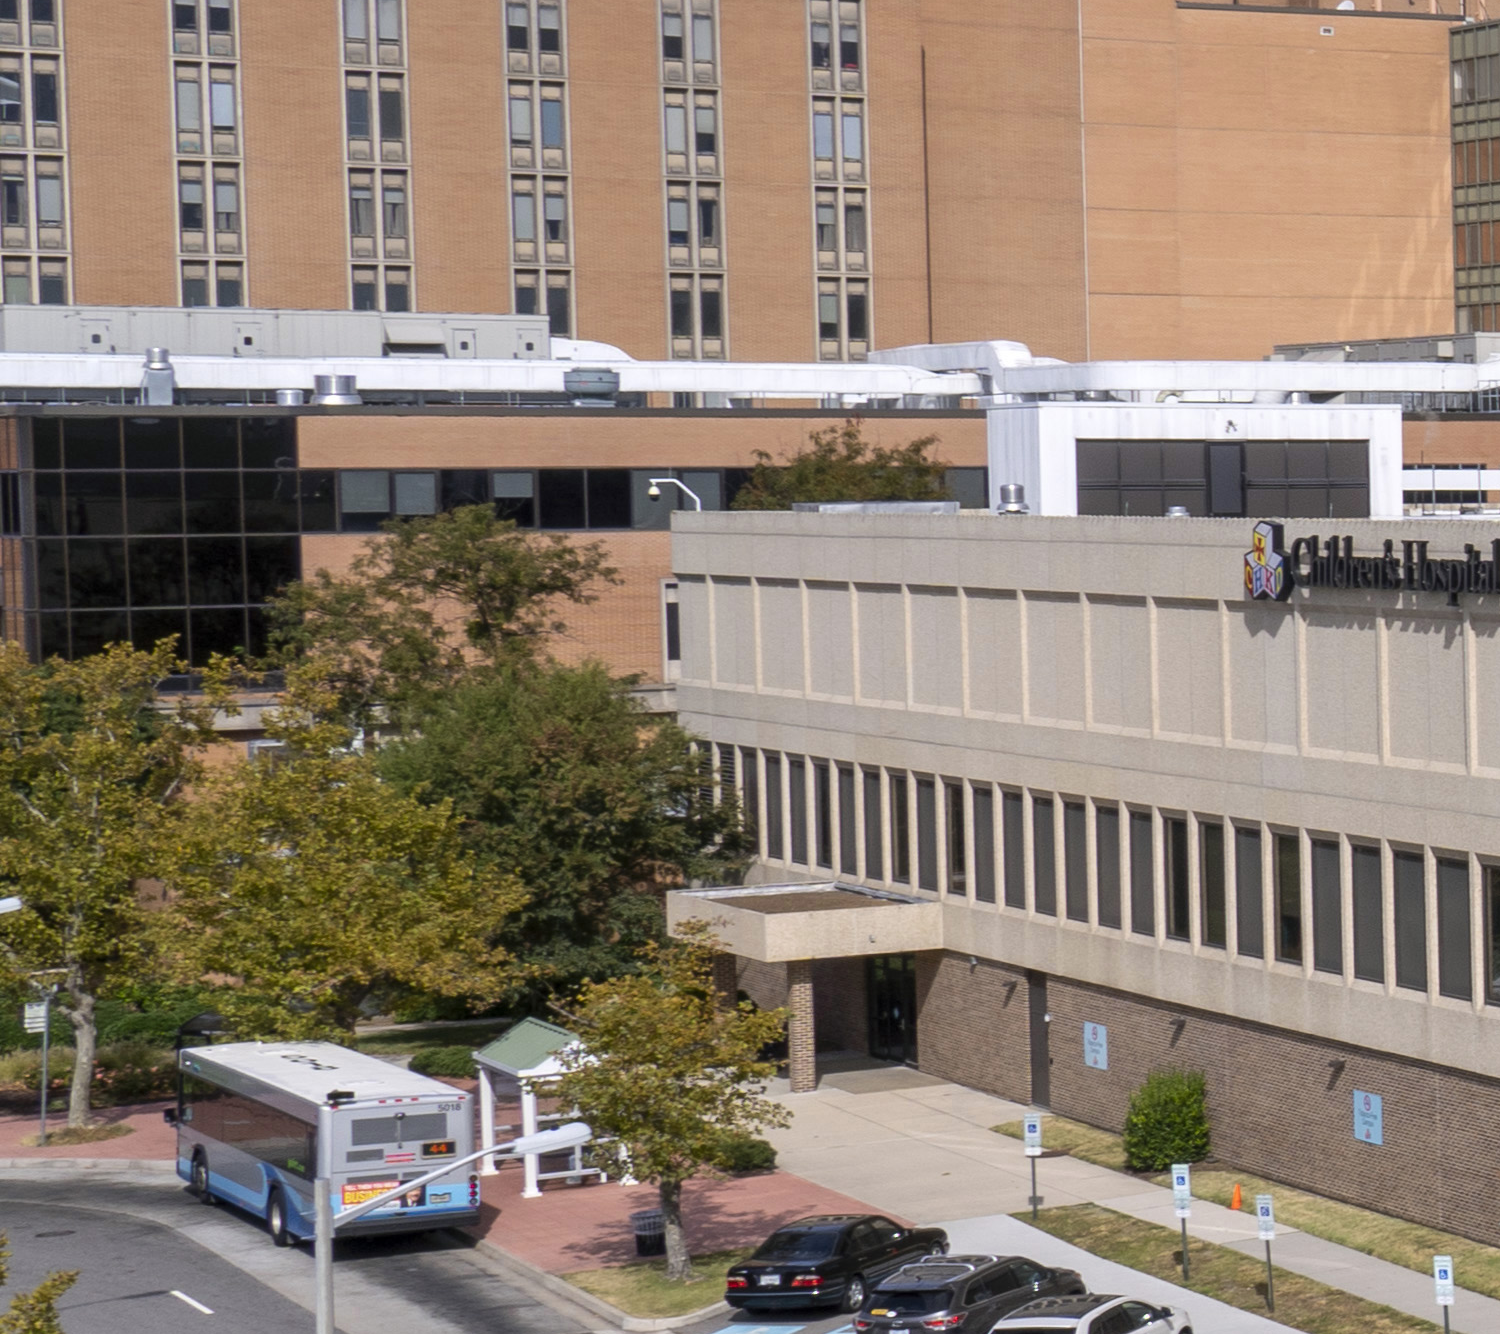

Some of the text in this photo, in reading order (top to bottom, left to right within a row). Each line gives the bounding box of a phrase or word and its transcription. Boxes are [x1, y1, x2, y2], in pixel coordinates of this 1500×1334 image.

[1291, 535, 1400, 589] Children's
[438, 1103, 462, 1112] 5018
[429, 1143, 448, 1154] 44
